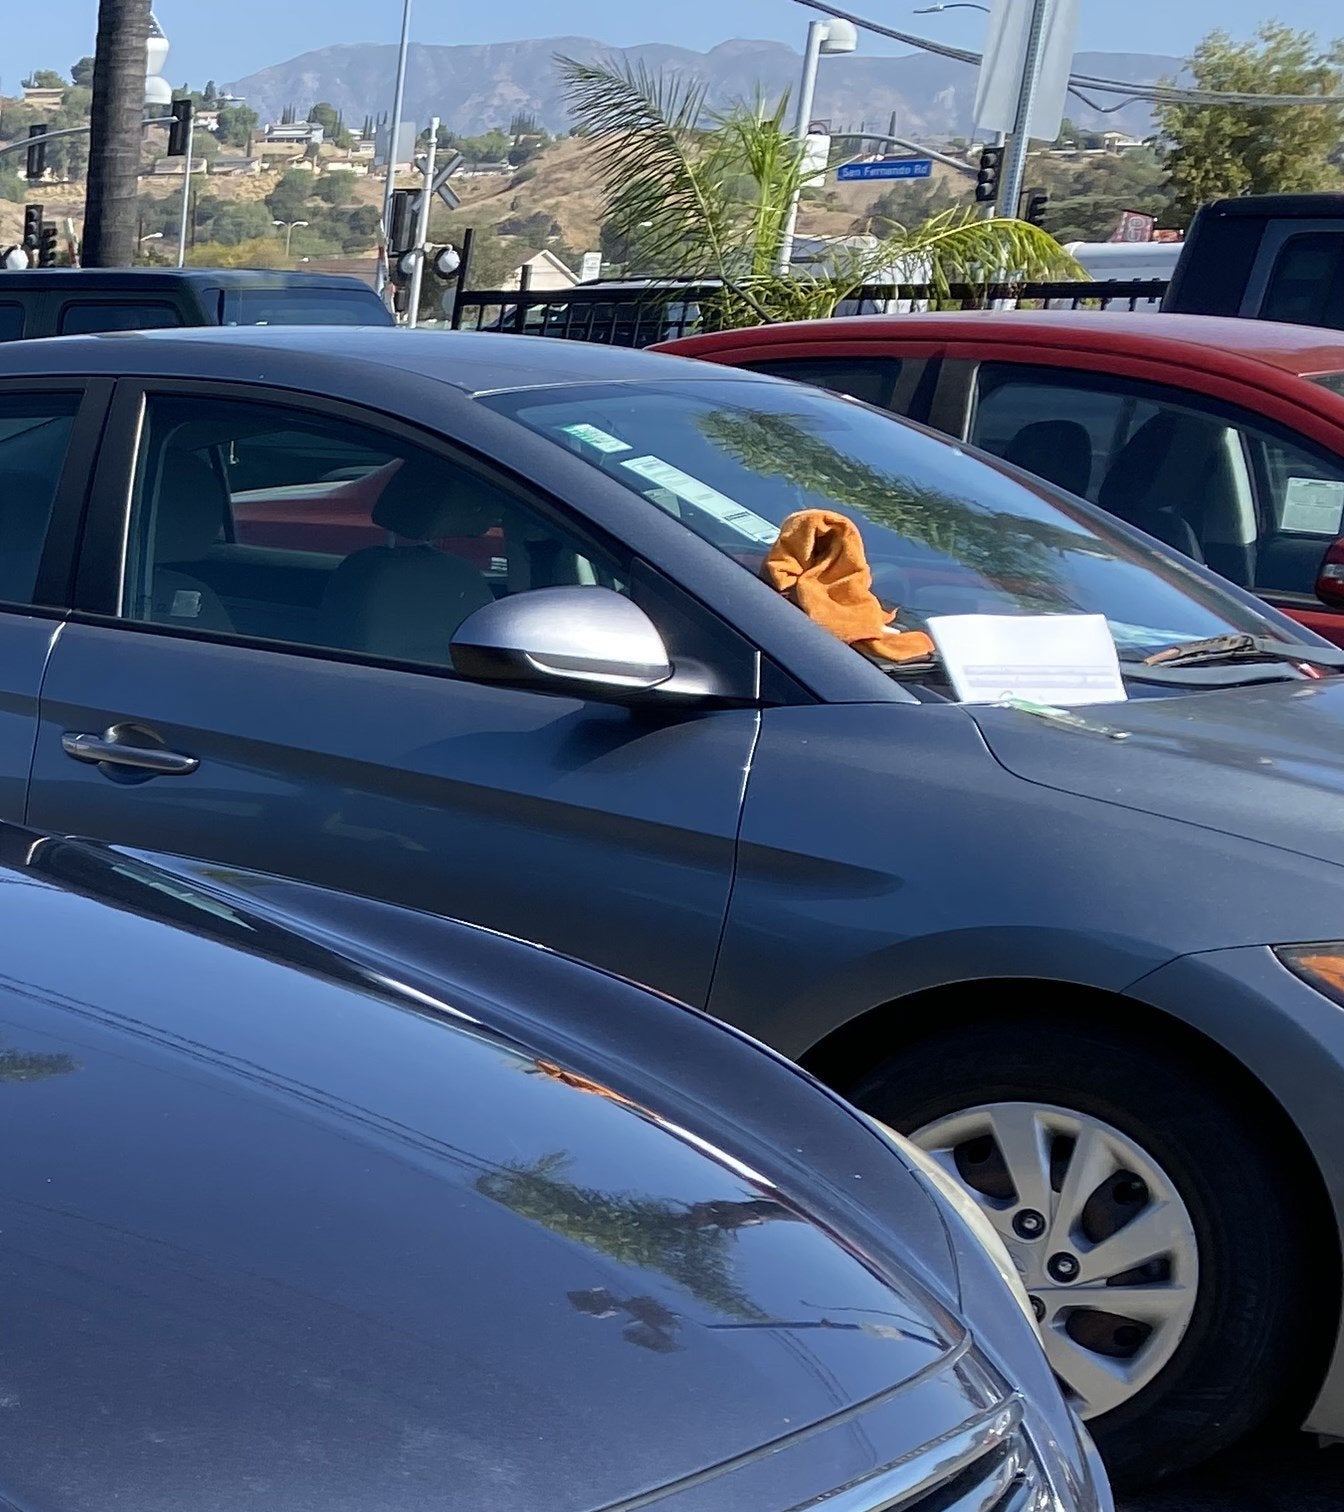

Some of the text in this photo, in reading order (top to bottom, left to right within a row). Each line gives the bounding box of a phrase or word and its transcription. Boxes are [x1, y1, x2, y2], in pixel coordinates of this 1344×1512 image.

[842, 164, 928, 177] San Fernando Rd
